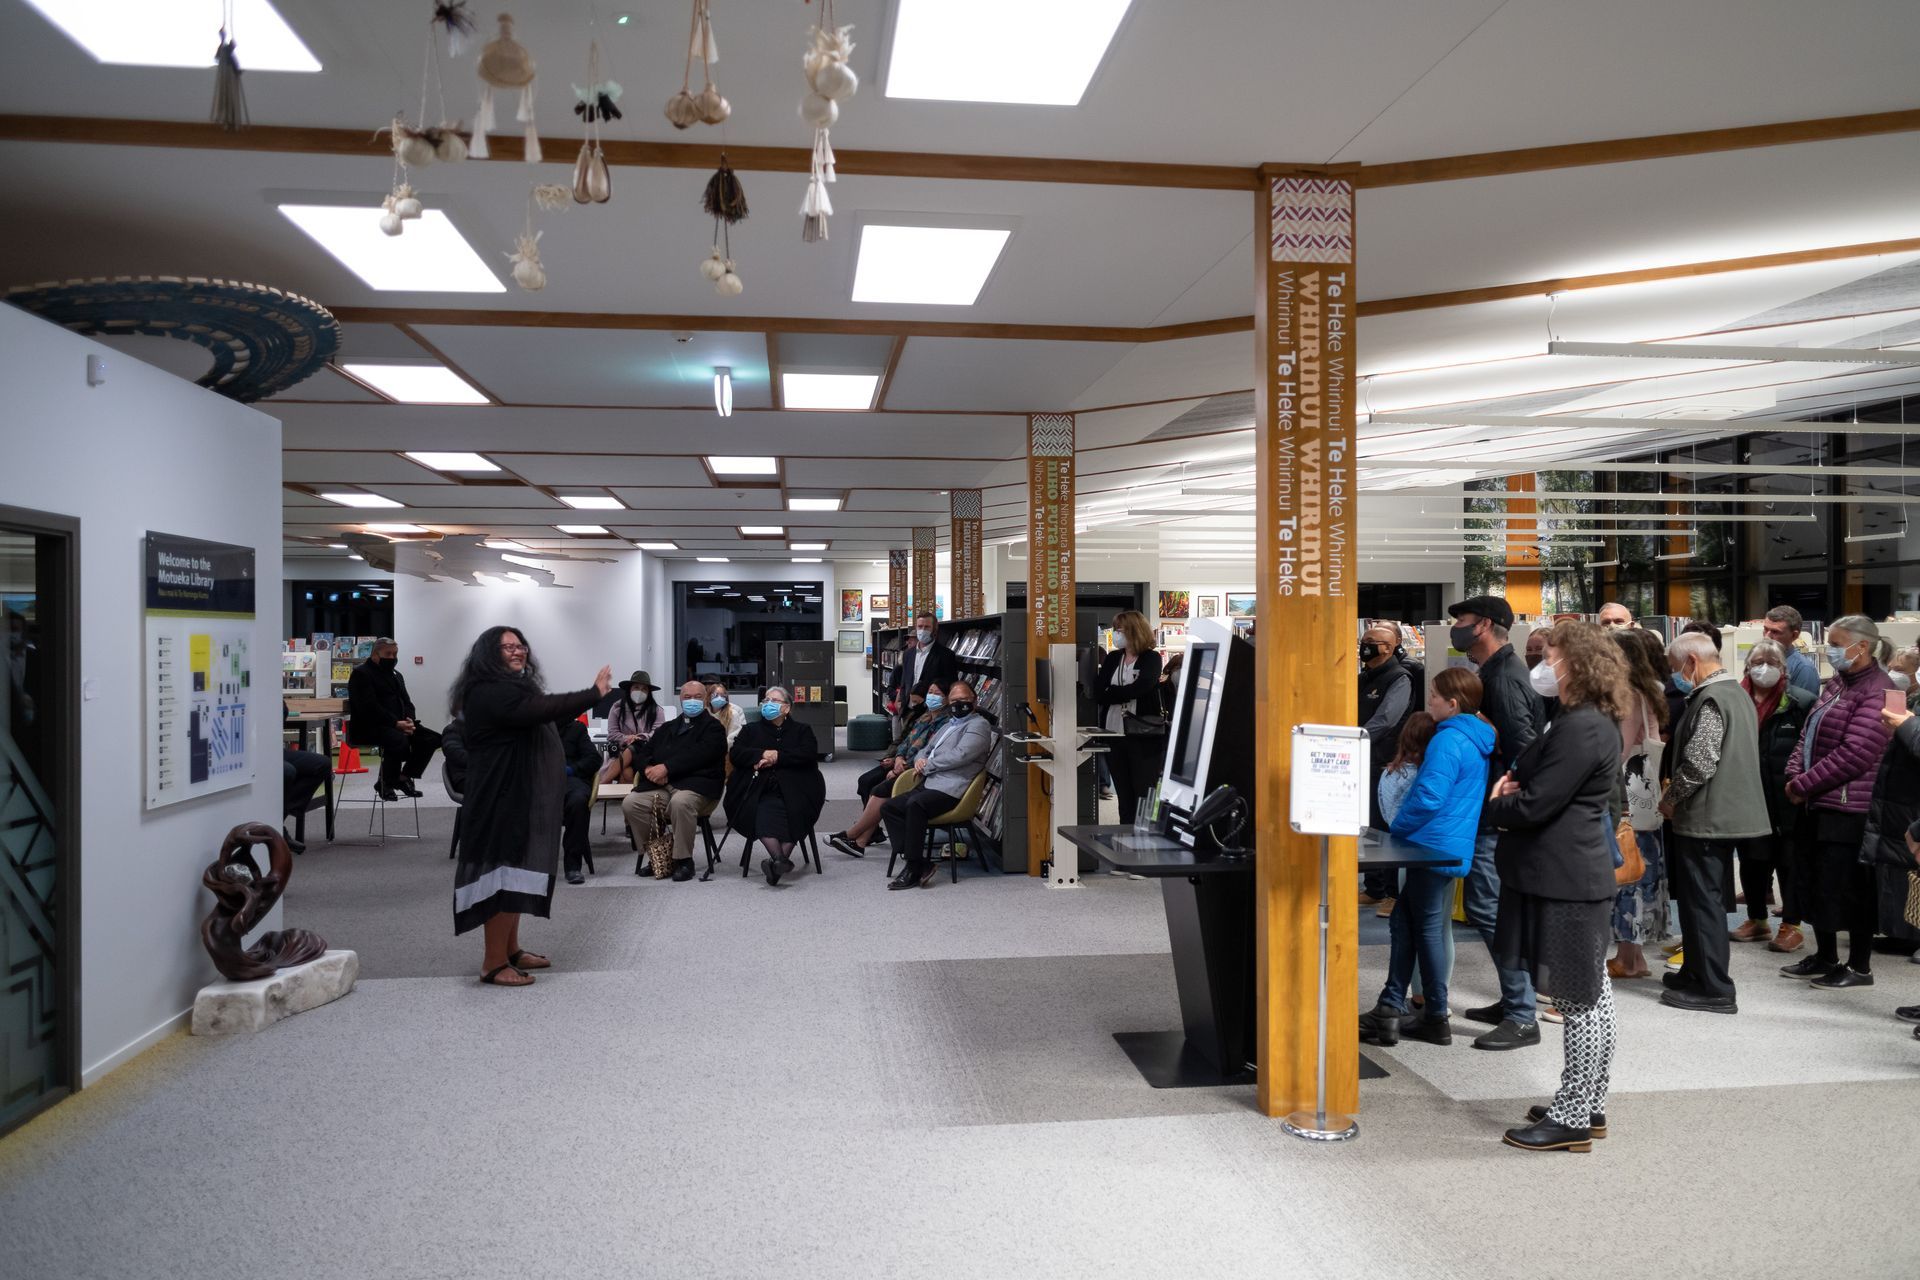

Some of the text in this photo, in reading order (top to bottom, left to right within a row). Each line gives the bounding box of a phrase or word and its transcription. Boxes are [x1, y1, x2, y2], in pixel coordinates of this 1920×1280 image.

[1278, 270, 1298, 597] Whirinui Te Heke Whirinui Te Heke
[1327, 272, 1347, 597] Te Heke Whirinui Te Heke Whirinui
[1034, 460, 1044, 482] Niho
[1060, 460, 1070, 474] Te
[1060, 476, 1070, 502] Heke
[1035, 506, 1044, 520] Te
[1060, 503, 1070, 526] Niho
[1035, 522, 1045, 547] Heke
[158, 551, 211, 571] Welcome to the
[1035, 549, 1044, 570] Niho
[1060, 550, 1070, 563] Te
[158, 569, 215, 591] Motueka Library
[1060, 565, 1071, 591] Heke
[1035, 595, 1045, 609] Te
[1060, 593, 1070, 615] Niho
[1035, 611, 1045, 637] Heke
